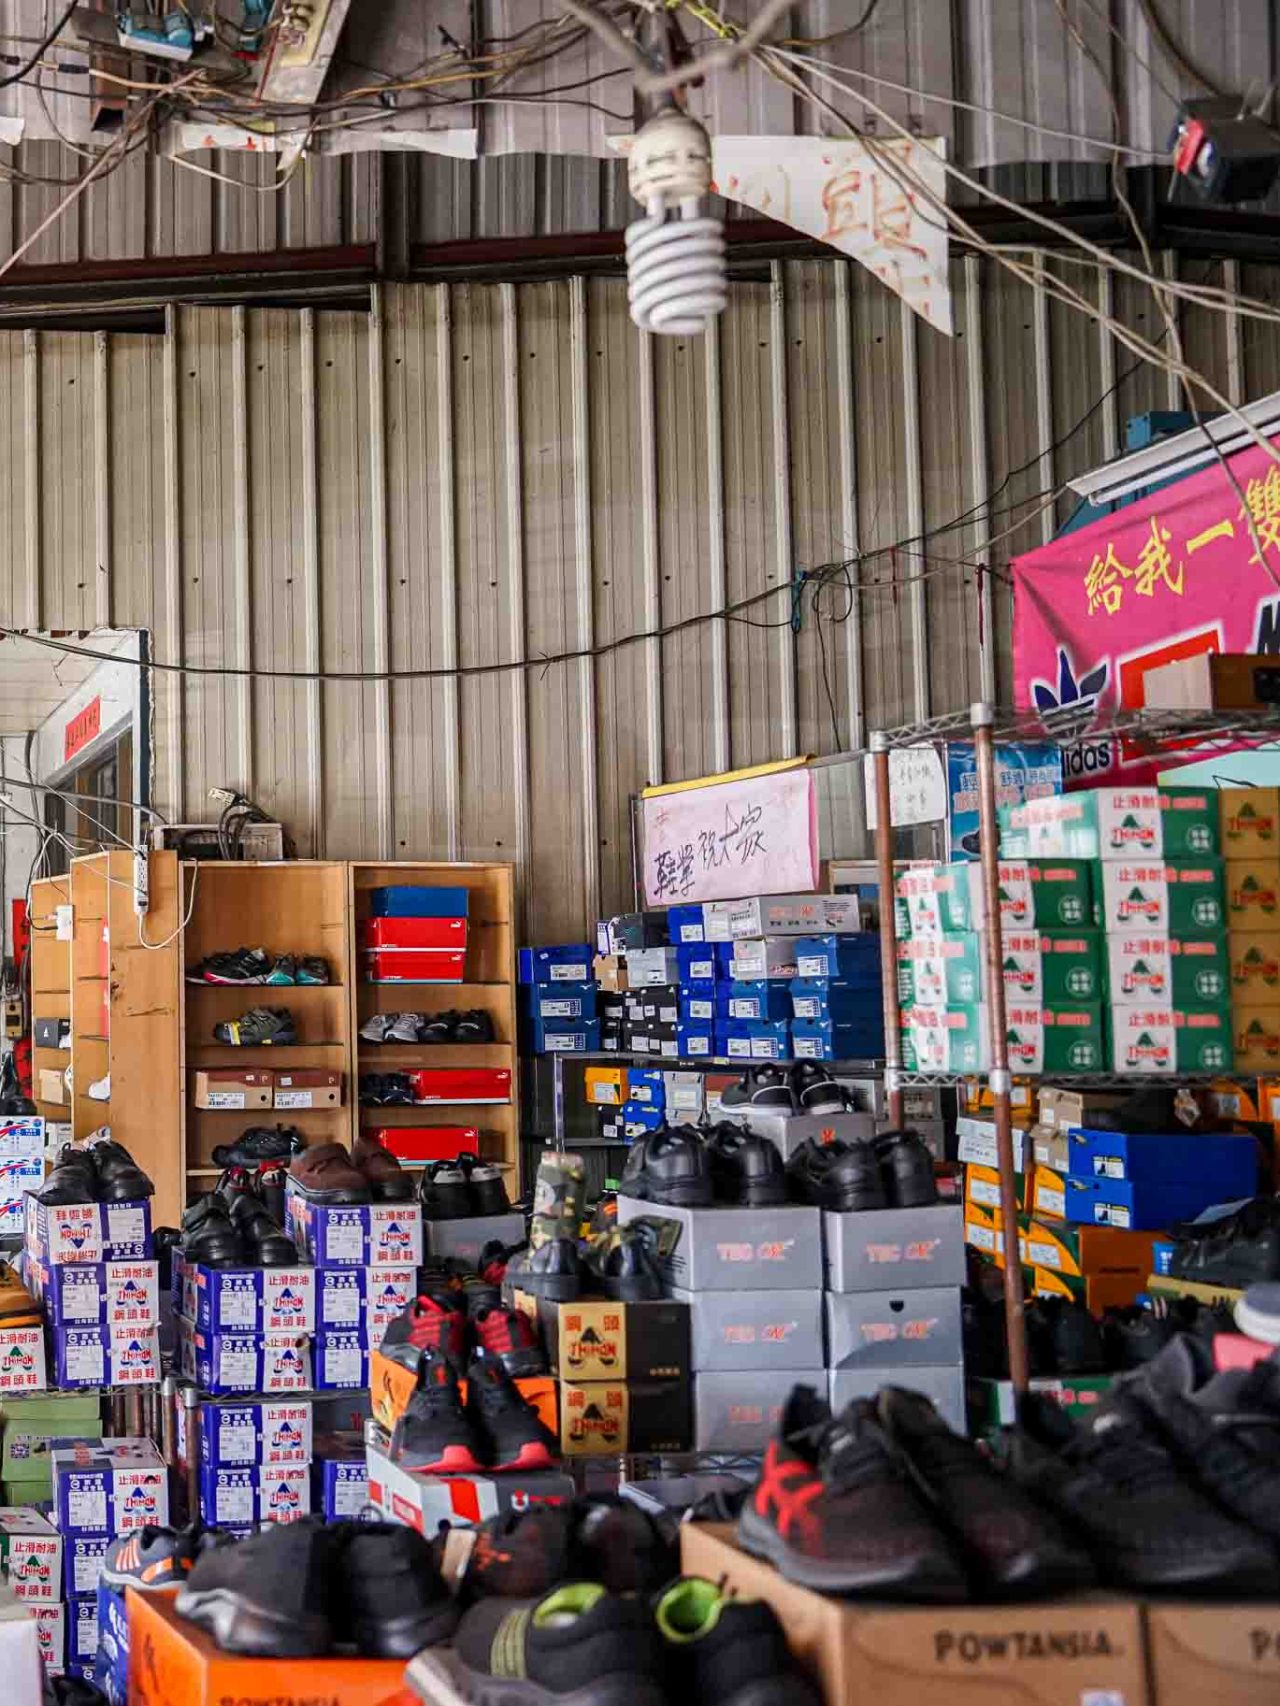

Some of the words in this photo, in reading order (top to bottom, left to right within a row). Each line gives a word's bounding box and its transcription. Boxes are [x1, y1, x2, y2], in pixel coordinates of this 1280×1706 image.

[1061, 742, 1111, 779] idas
[0, 1374, 38, 1386] 鋼頭鞋
[14, 1542, 57, 1554] 止滑耐油
